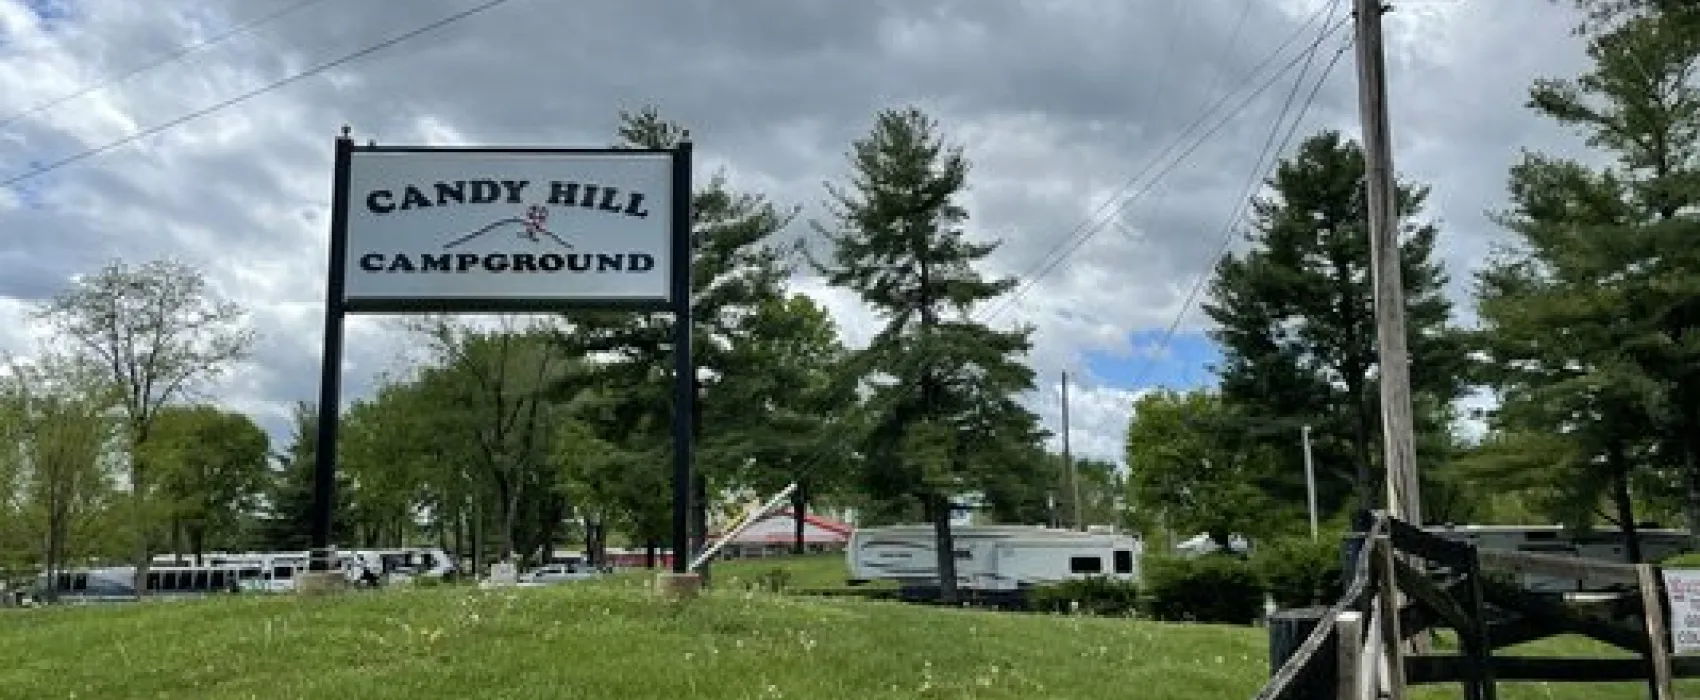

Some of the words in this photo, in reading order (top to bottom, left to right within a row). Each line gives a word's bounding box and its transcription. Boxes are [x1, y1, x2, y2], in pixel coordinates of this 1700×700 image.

[366, 179, 529, 215] CANDY
[546, 180, 649, 217] HILL
[359, 253, 655, 273] CAMPGROUND
